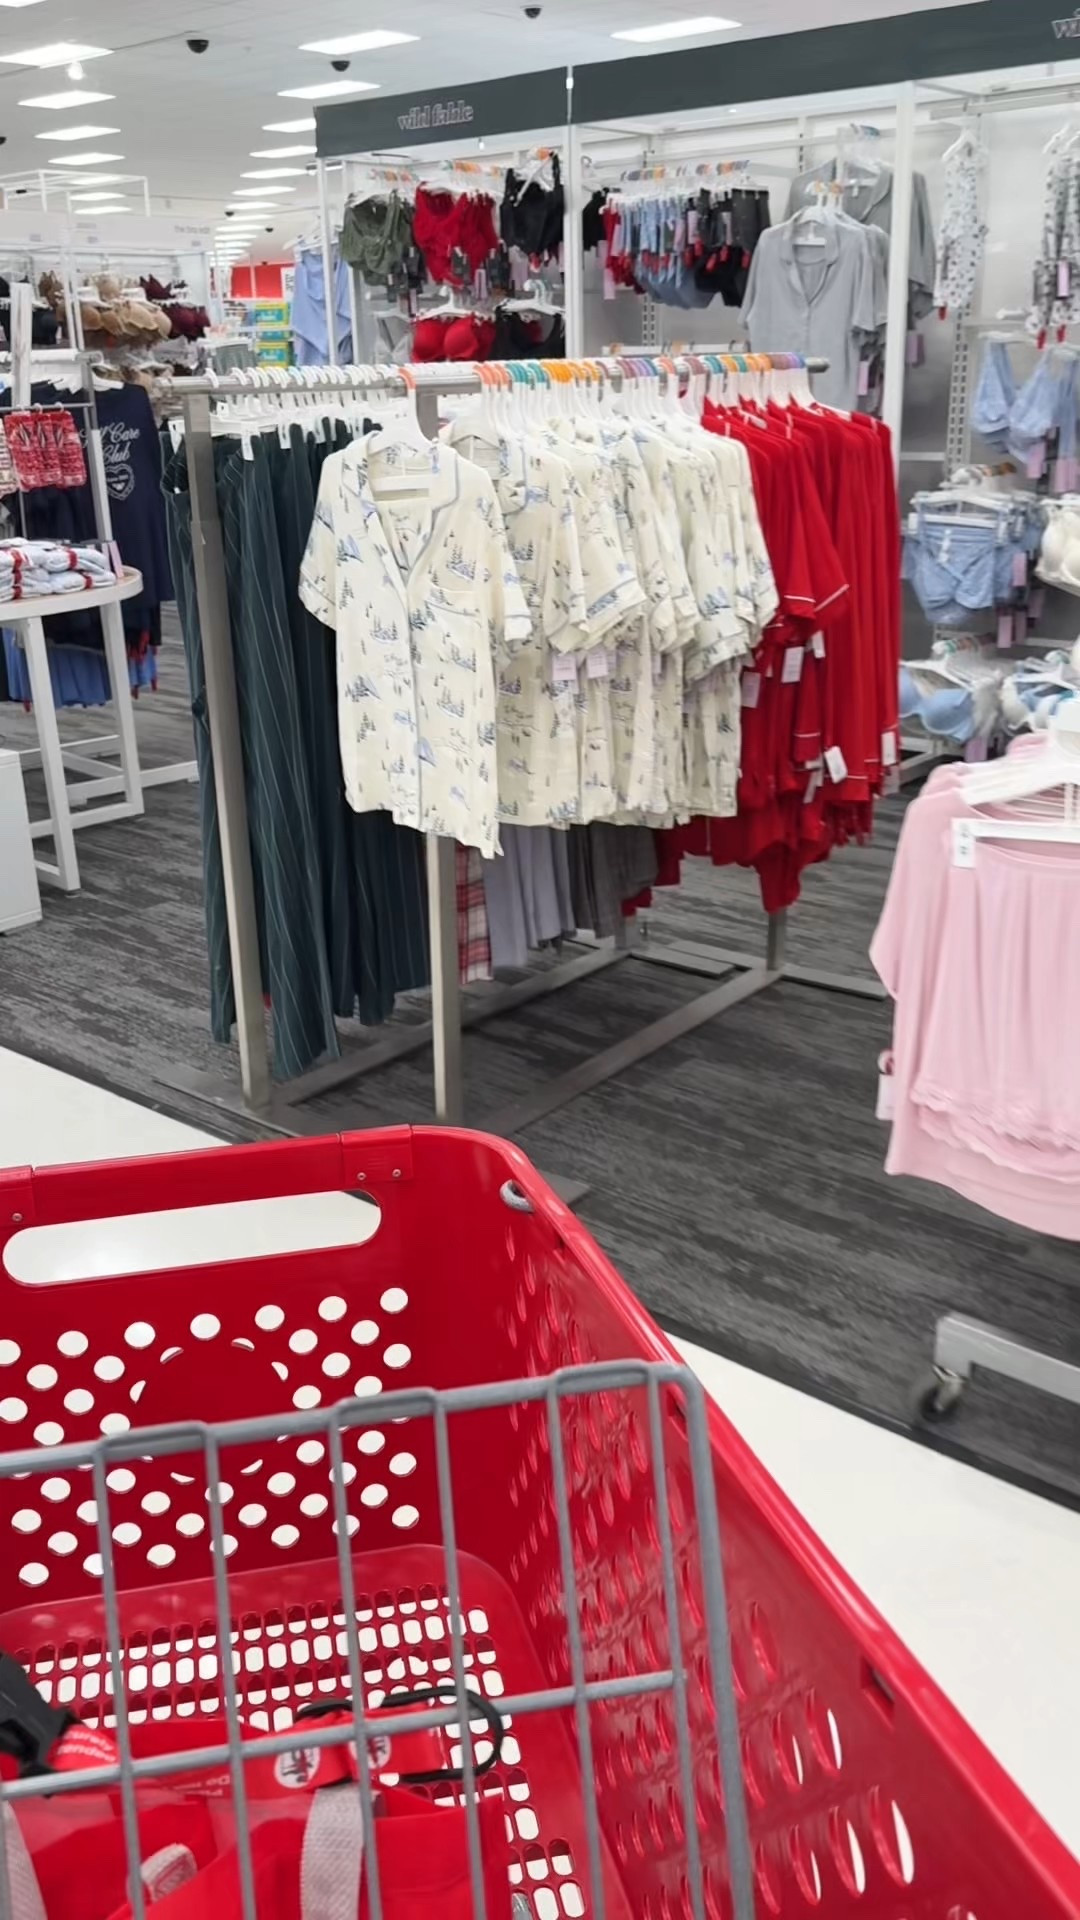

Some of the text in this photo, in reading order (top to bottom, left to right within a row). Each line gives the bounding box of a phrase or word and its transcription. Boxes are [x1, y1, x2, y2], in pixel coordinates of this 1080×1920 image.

[1051, 8, 1080, 39] wi
[397, 100, 474, 130] wild fable
[109, 422, 140, 443] Care
[103, 441, 131, 465] Club
